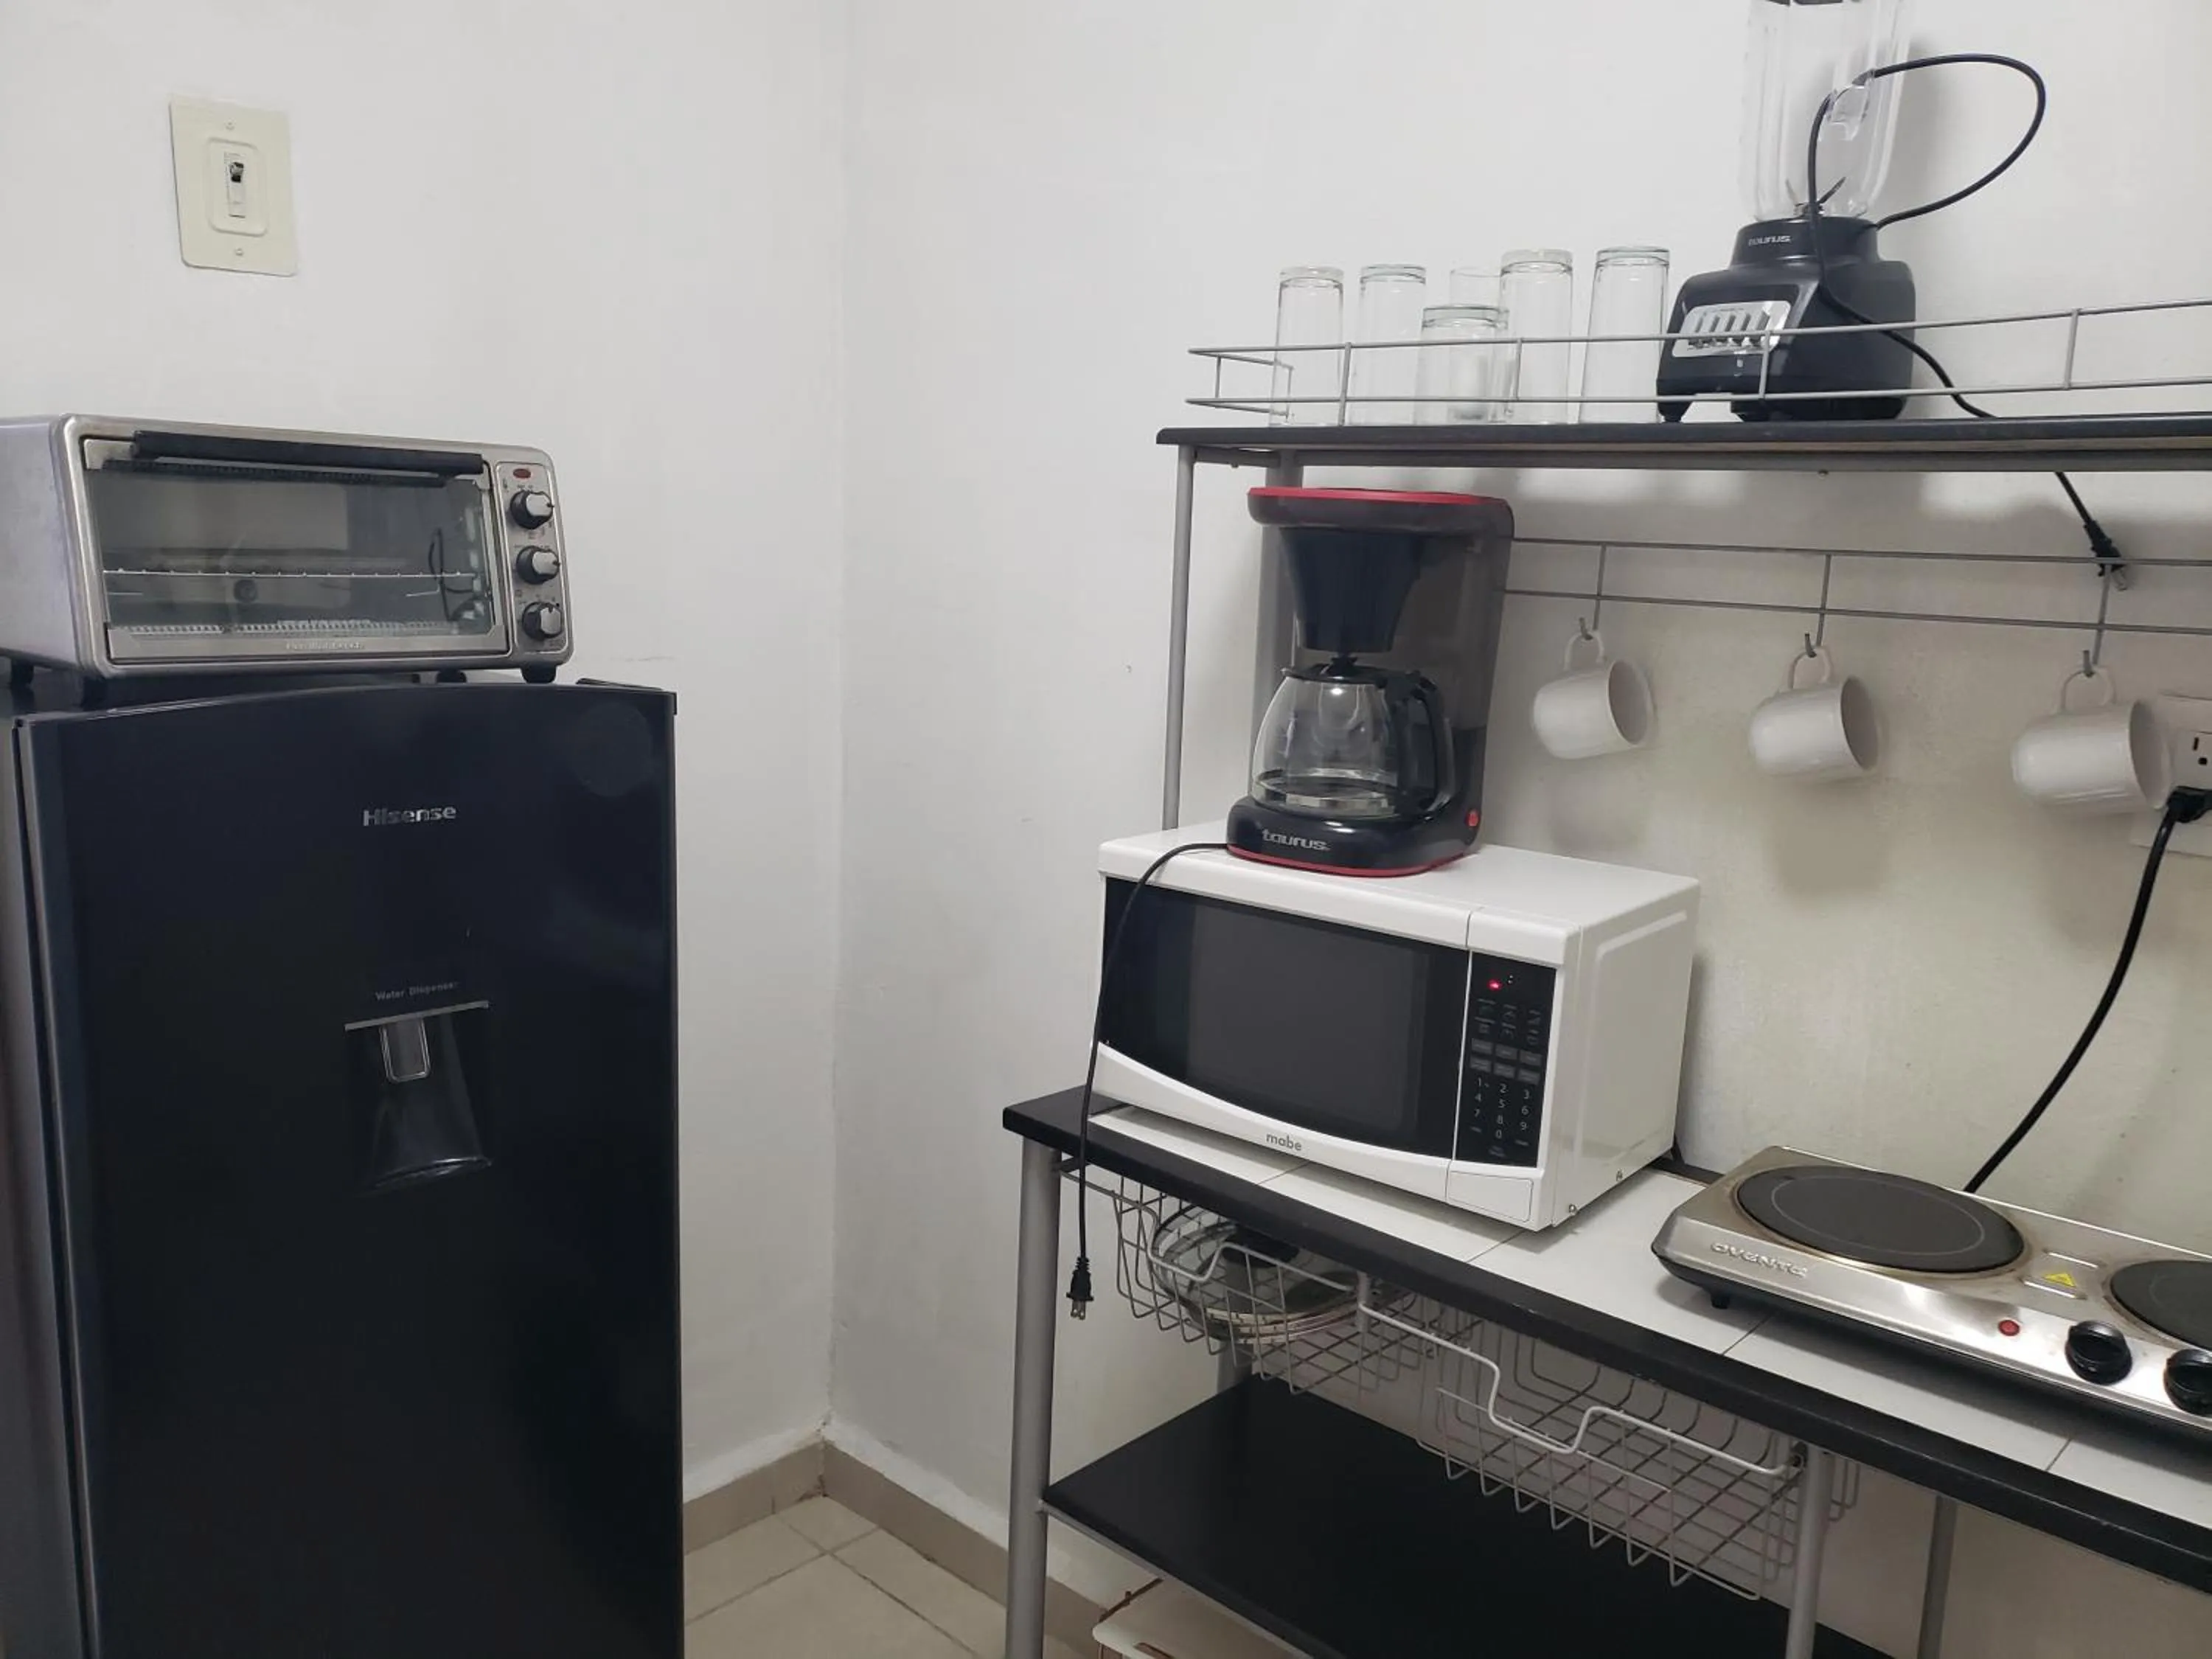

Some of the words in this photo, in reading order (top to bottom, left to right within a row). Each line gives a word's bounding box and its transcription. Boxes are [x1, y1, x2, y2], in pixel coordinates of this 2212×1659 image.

[362, 806, 456, 827] Hisense
[1262, 828, 1329, 851] taurus
[375, 990, 404, 1001] Water
[1499, 1083, 1508, 1093] 2
[1498, 1099, 1506, 1108] 5
[1521, 1105, 1529, 1116] 6
[1520, 1121, 1528, 1131] 9
[1495, 1129, 1503, 1139] 0
[1266, 1133, 1302, 1151] mabe
